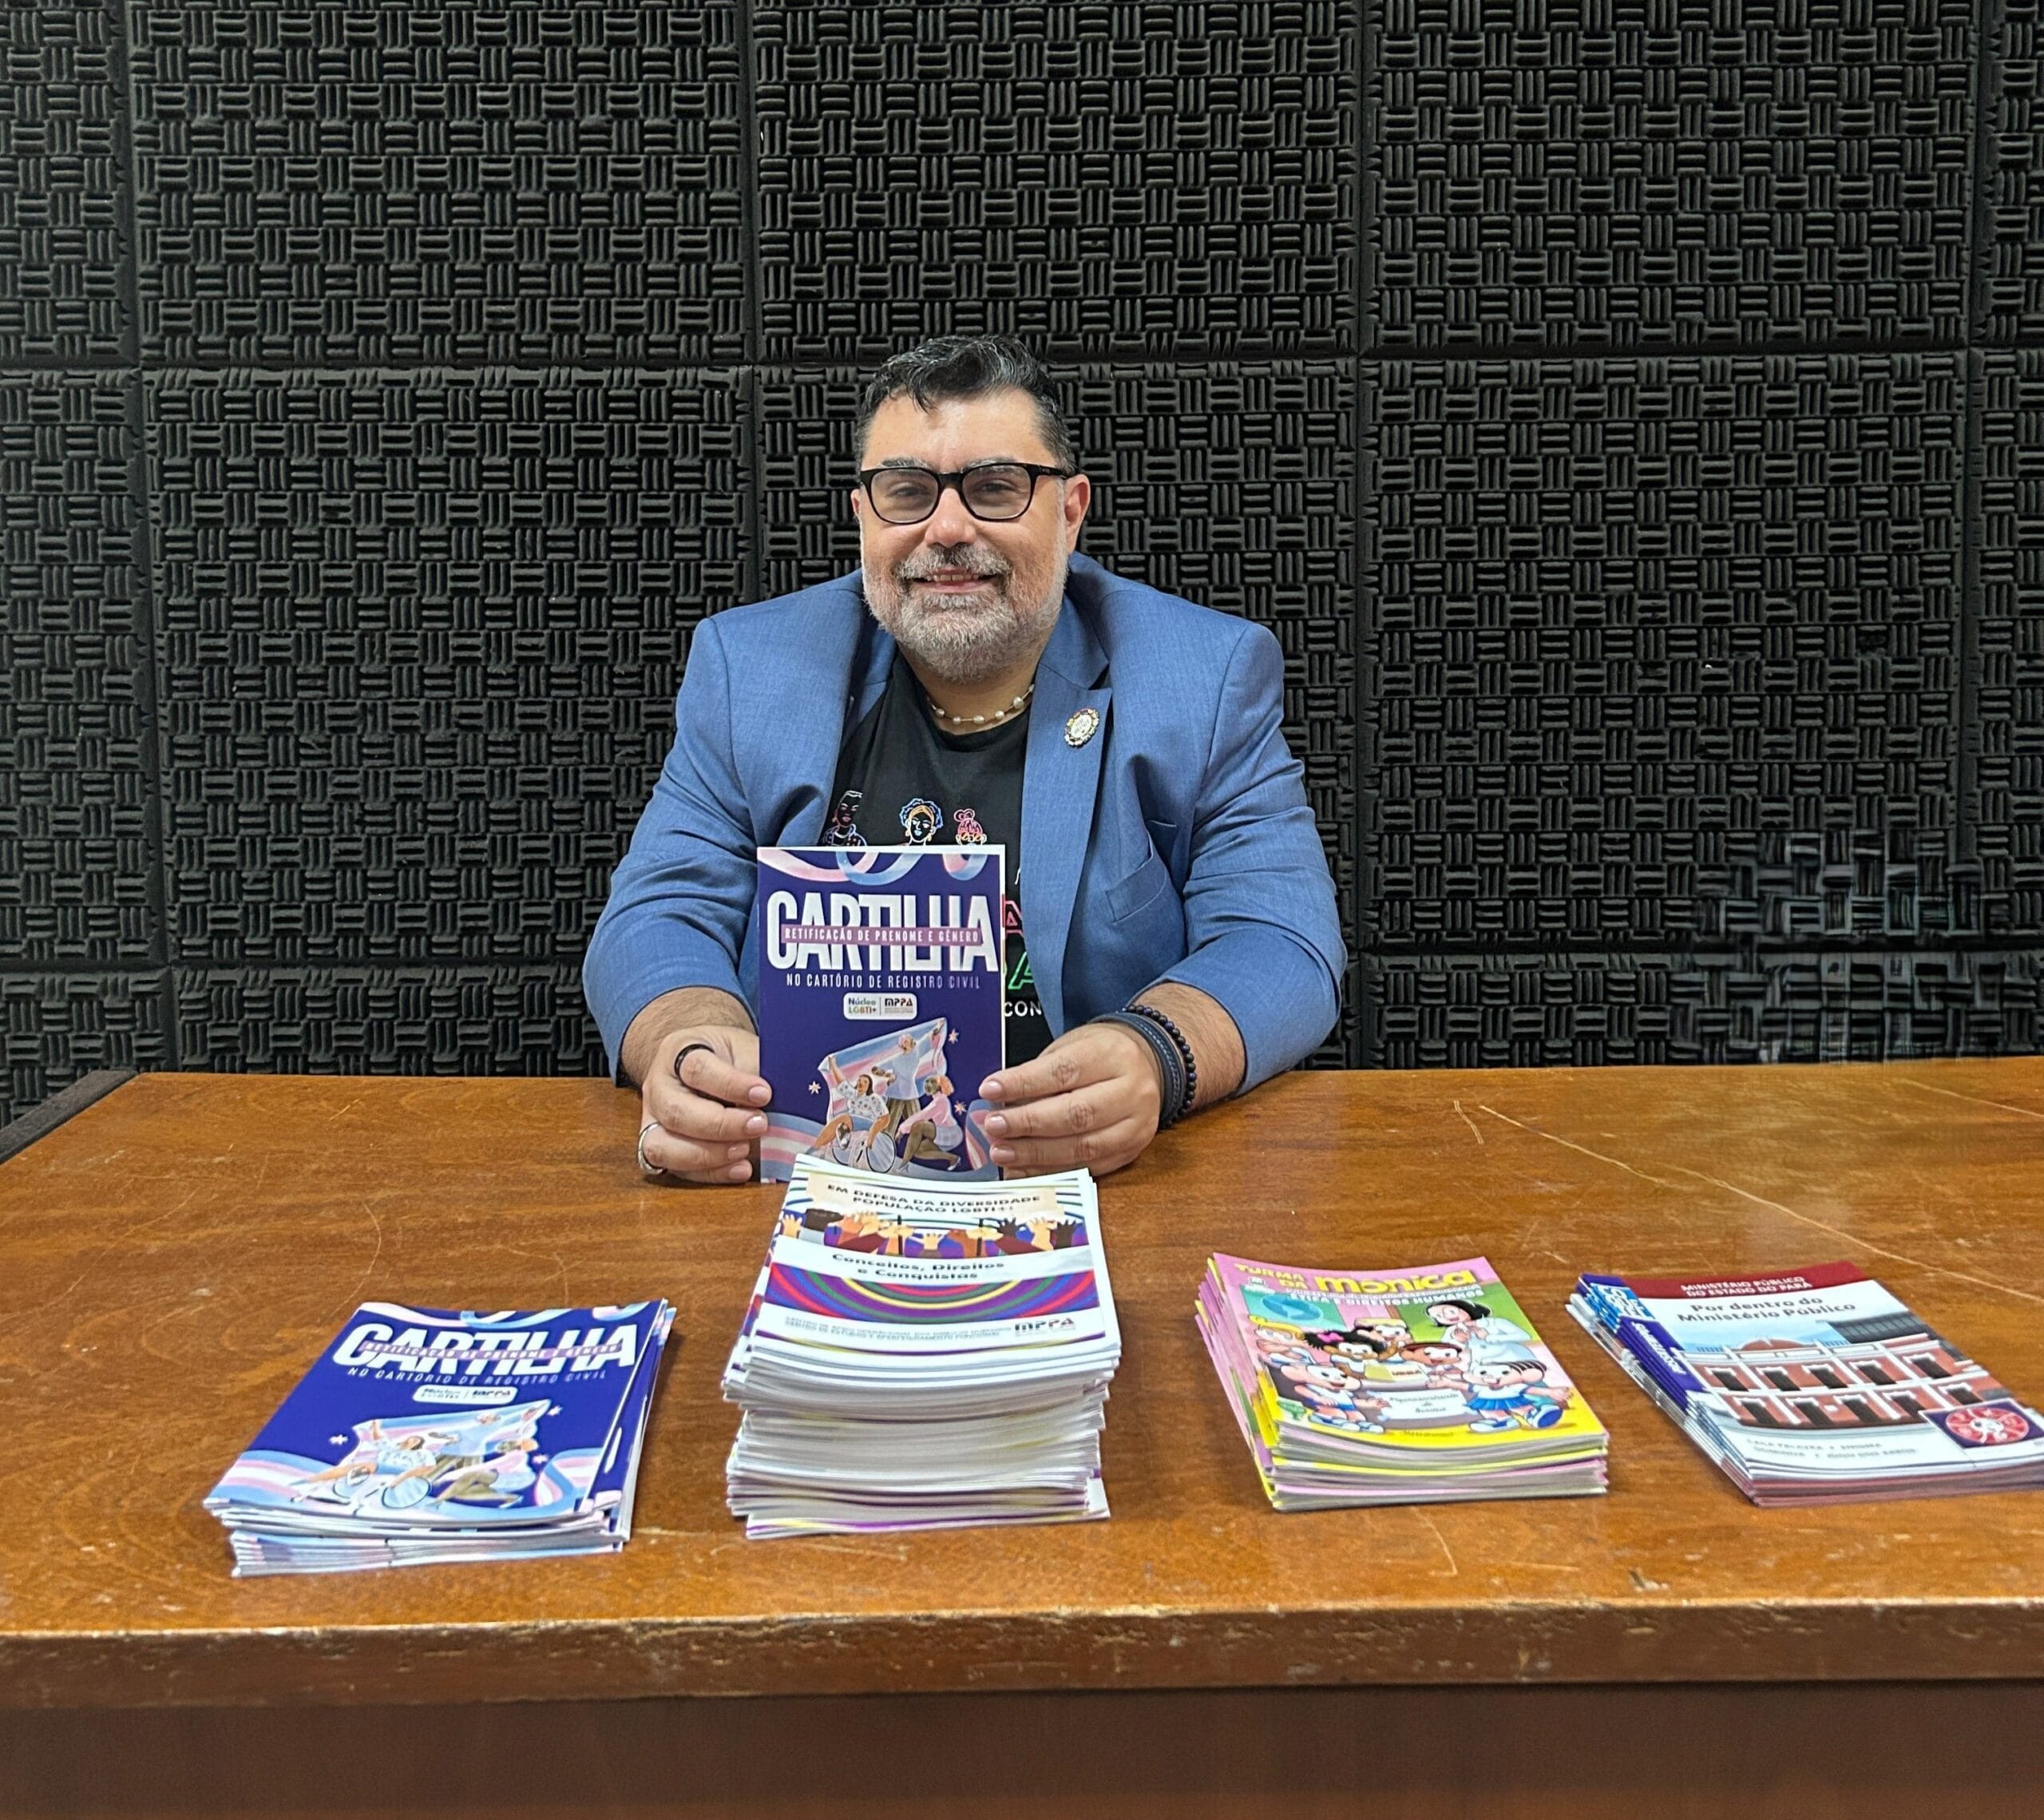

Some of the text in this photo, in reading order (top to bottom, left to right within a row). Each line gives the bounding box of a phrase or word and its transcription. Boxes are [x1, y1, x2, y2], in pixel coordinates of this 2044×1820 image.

[766, 890, 999, 972] CARTILHA
[785, 926, 979, 942] RETIFICAÇÃO DE PRENOME E GÊNERO
[786, 971, 980, 989] NO CARTÓRIO DE REGISTRO CIVIL
[827, 1184, 849, 1195] EM
[854, 1189, 909, 1203] DEFESA
[940, 1195, 1040, 1207] DIVERSIDADE
[852, 1196, 947, 1213] POPULAÇÃO
[832, 1254, 925, 1271] Conceitos,
[875, 1269, 978, 1279] Conquistas
[1234, 1263, 1305, 1283] TURMA
[1278, 1279, 1309, 1290] DA
[1680, 1276, 1805, 1292] MINISTÉRIO PÚBLICO
[1709, 1287, 1757, 1296] ESTADO
[1780, 1281, 1813, 1290] PARÁ
[1413, 1289, 1486, 1305] HUMANOS
[1690, 1303, 1725, 1312] Por
[1729, 1299, 1795, 1310] dentro
[1678, 1303, 1856, 1322] Ministério Público
[332, 1323, 637, 1375] CARTILHA
[347, 1366, 368, 1378] NO
[458, 1375, 477, 1386] DE
[483, 1374, 558, 1386] REGISTRO
[564, 1370, 606, 1382] CIVIL
